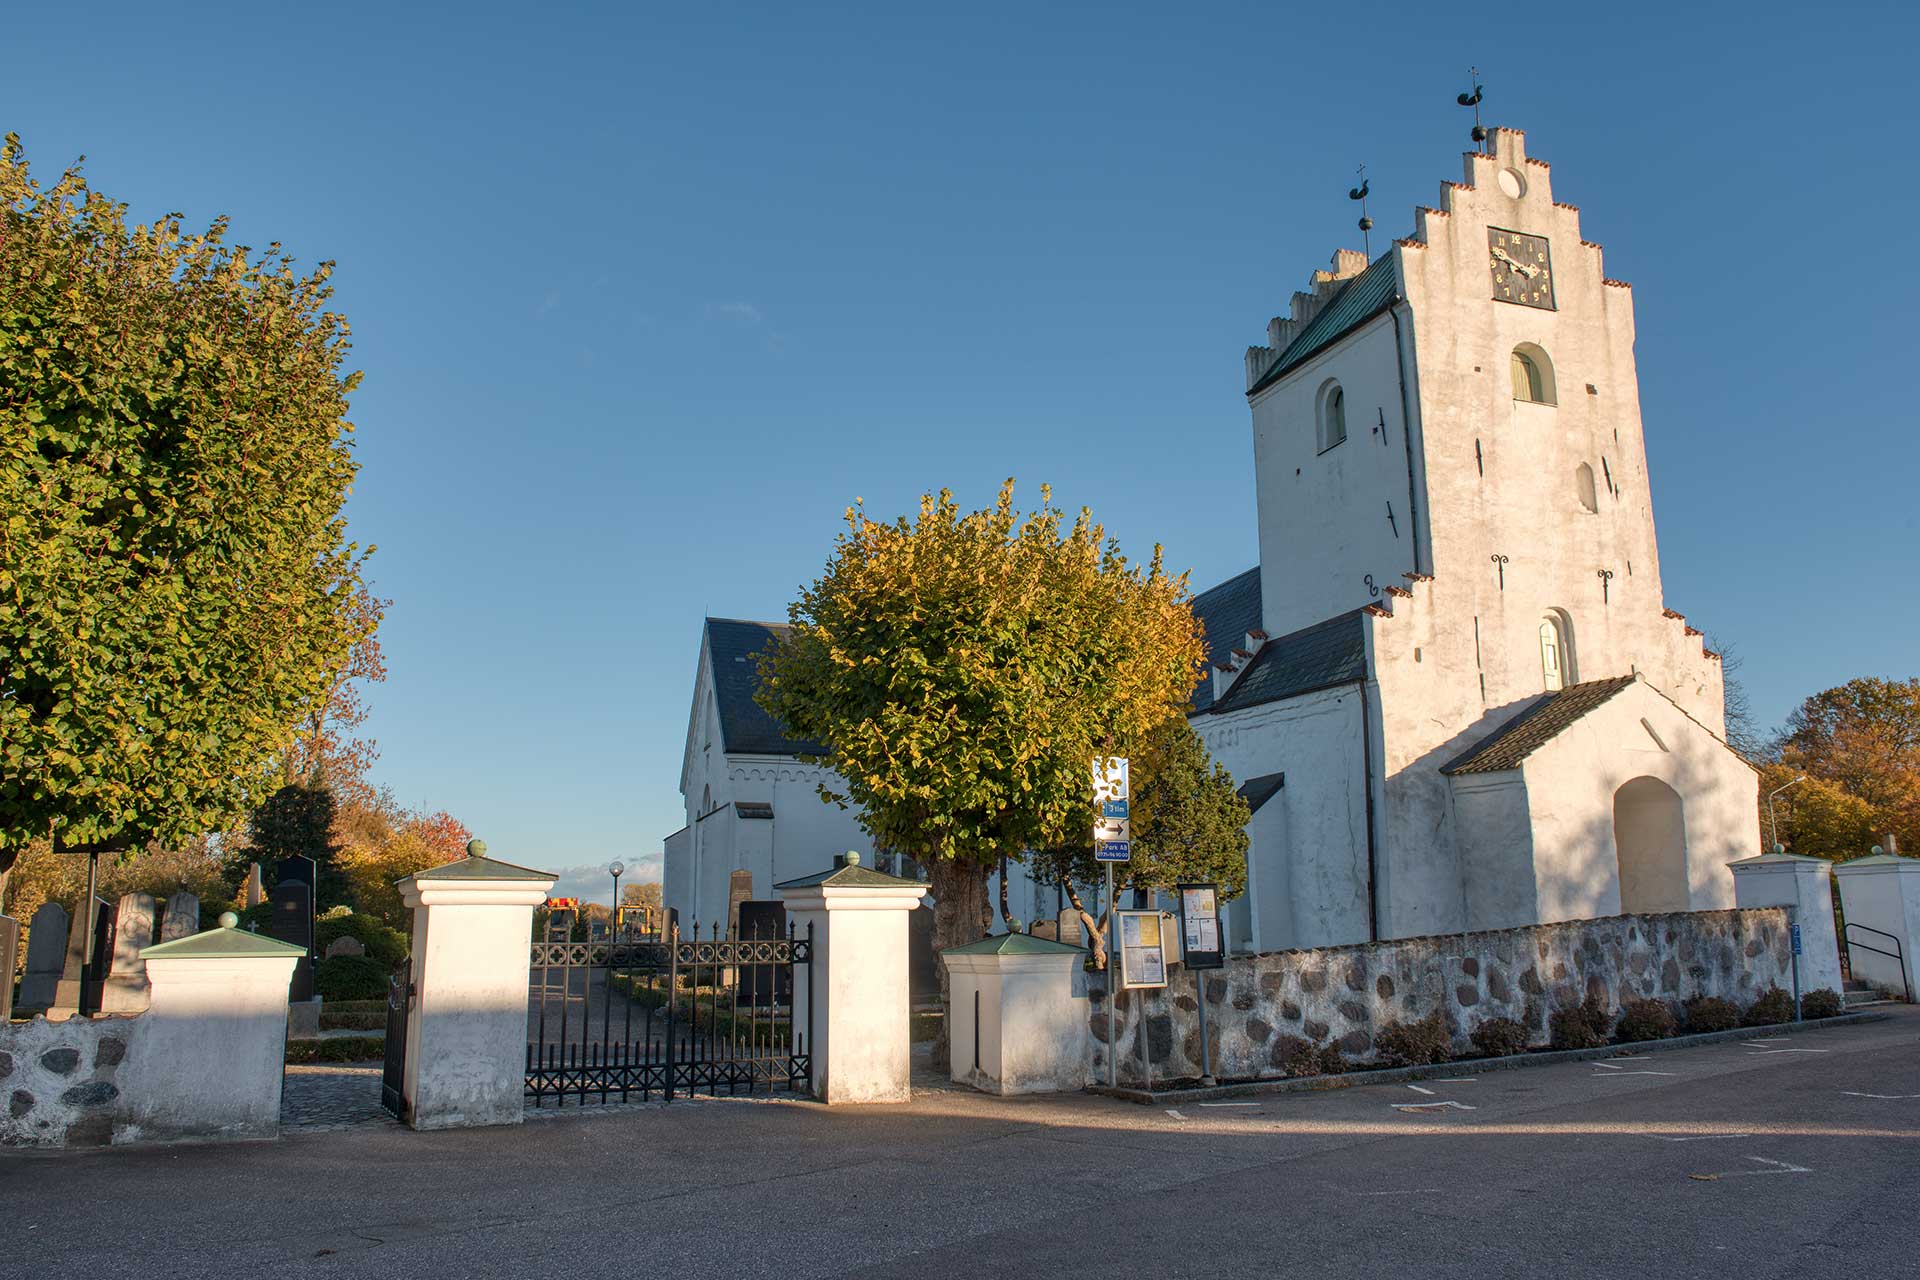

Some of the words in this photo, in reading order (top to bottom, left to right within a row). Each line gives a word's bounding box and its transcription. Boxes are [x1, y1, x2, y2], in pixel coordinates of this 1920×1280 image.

[1498, 237, 1505, 246] 11
[1511, 235, 1521, 245] 12
[1529, 242, 1533, 252] 1
[1537, 252, 1545, 263] 2
[1490, 259, 1497, 269] 9
[1496, 273, 1503, 284] 8
[1542, 269, 1549, 279] 3
[1504, 287, 1510, 297] 7
[1540, 284, 1548, 294] 4
[1519, 293, 1527, 303] 6
[1533, 292, 1540, 302] 5
[1097, 843, 1118, 851] -Park
